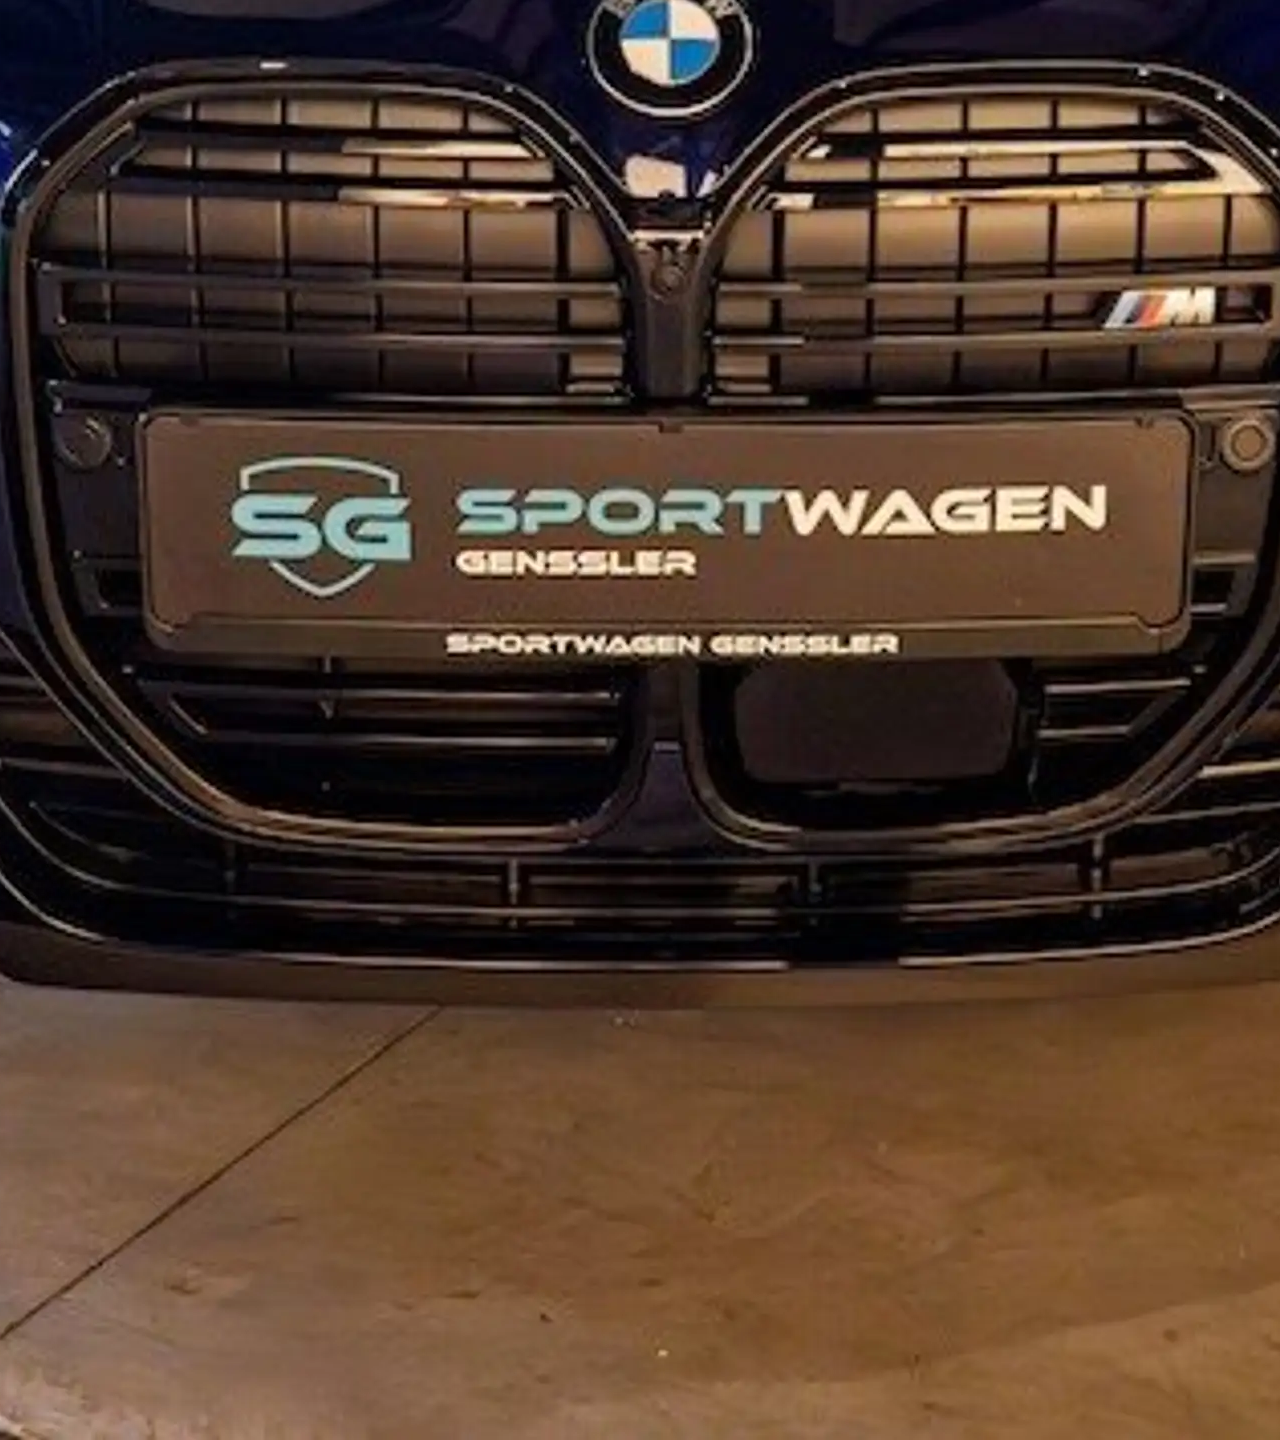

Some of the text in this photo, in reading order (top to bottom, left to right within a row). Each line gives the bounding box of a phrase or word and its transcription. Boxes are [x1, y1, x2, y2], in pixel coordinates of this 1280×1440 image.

[231, 492, 413, 561] SG
[455, 484, 1108, 536] SPORTWAGEN
[455, 549, 697, 577] GENSSLER
[445, 632, 900, 655] SPORTWAGEN GENSSLER
